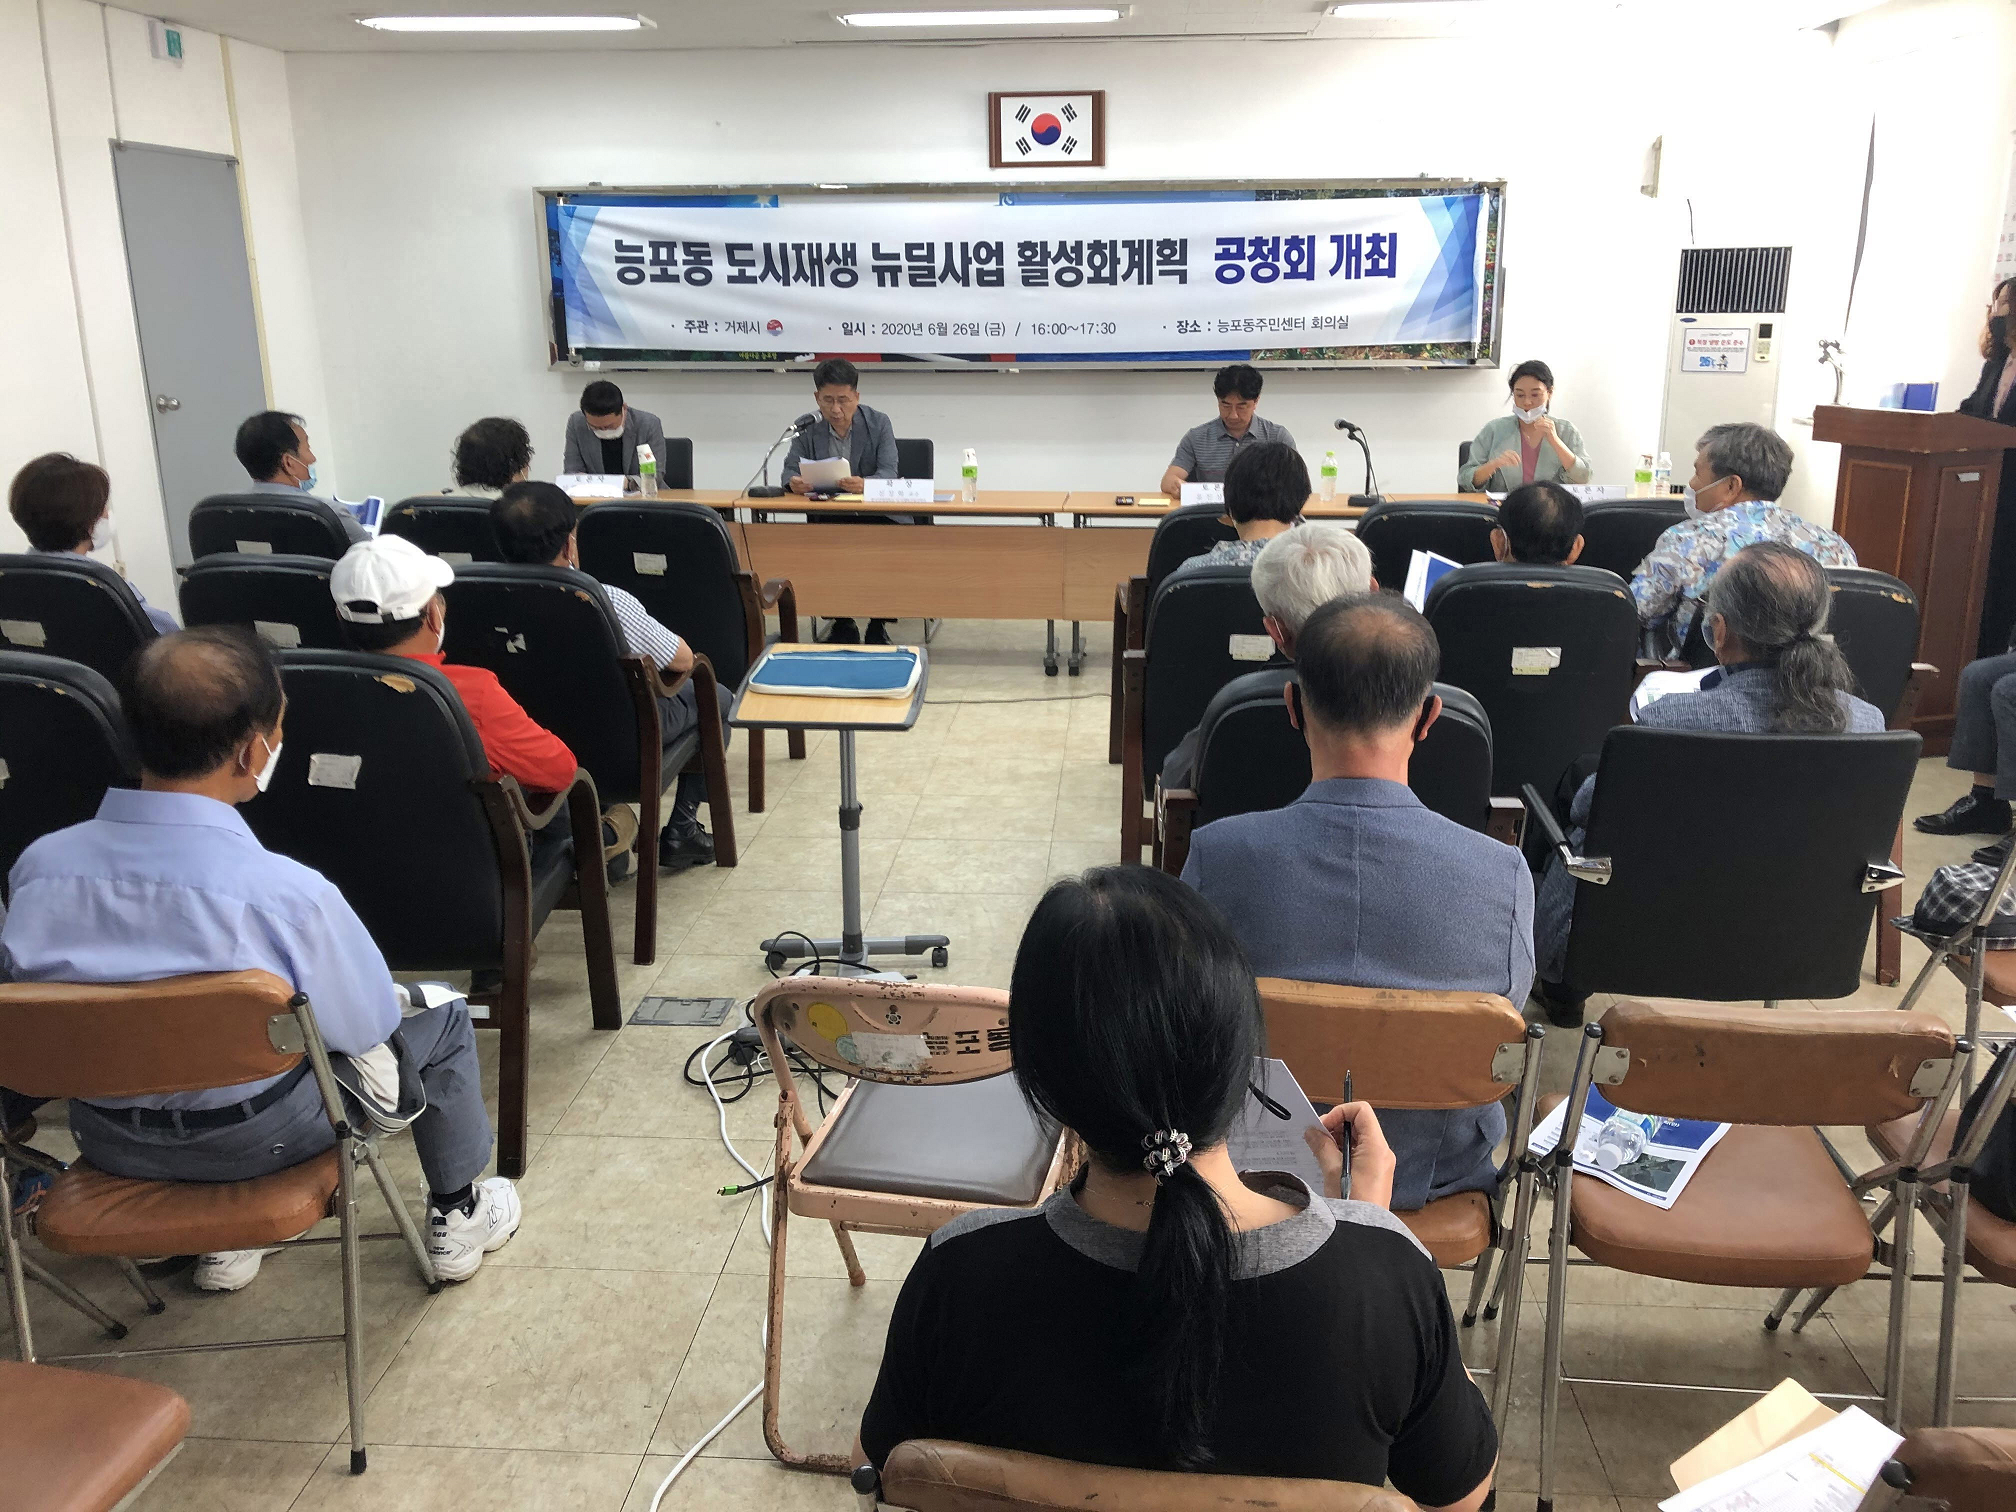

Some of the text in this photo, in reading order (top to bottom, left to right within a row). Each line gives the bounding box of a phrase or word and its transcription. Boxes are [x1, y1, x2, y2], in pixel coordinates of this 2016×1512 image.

[614, 232, 1398, 288] 능포동 도시재생 뉴딜사업 활성화계획 공청회 개최
[683, 320, 709, 334] 주관
[724, 321, 760, 335] 거제시
[841, 321, 866, 337] 일시
[881, 322, 923, 337] 2020년
[928, 322, 948, 337] 6월
[953, 322, 980, 337] 26일
[984, 322, 1006, 337] (금)
[1176, 320, 1202, 334] 장소
[1217, 317, 1305, 334] 능포동주민센터
[1310, 315, 1349, 330] 회의실
